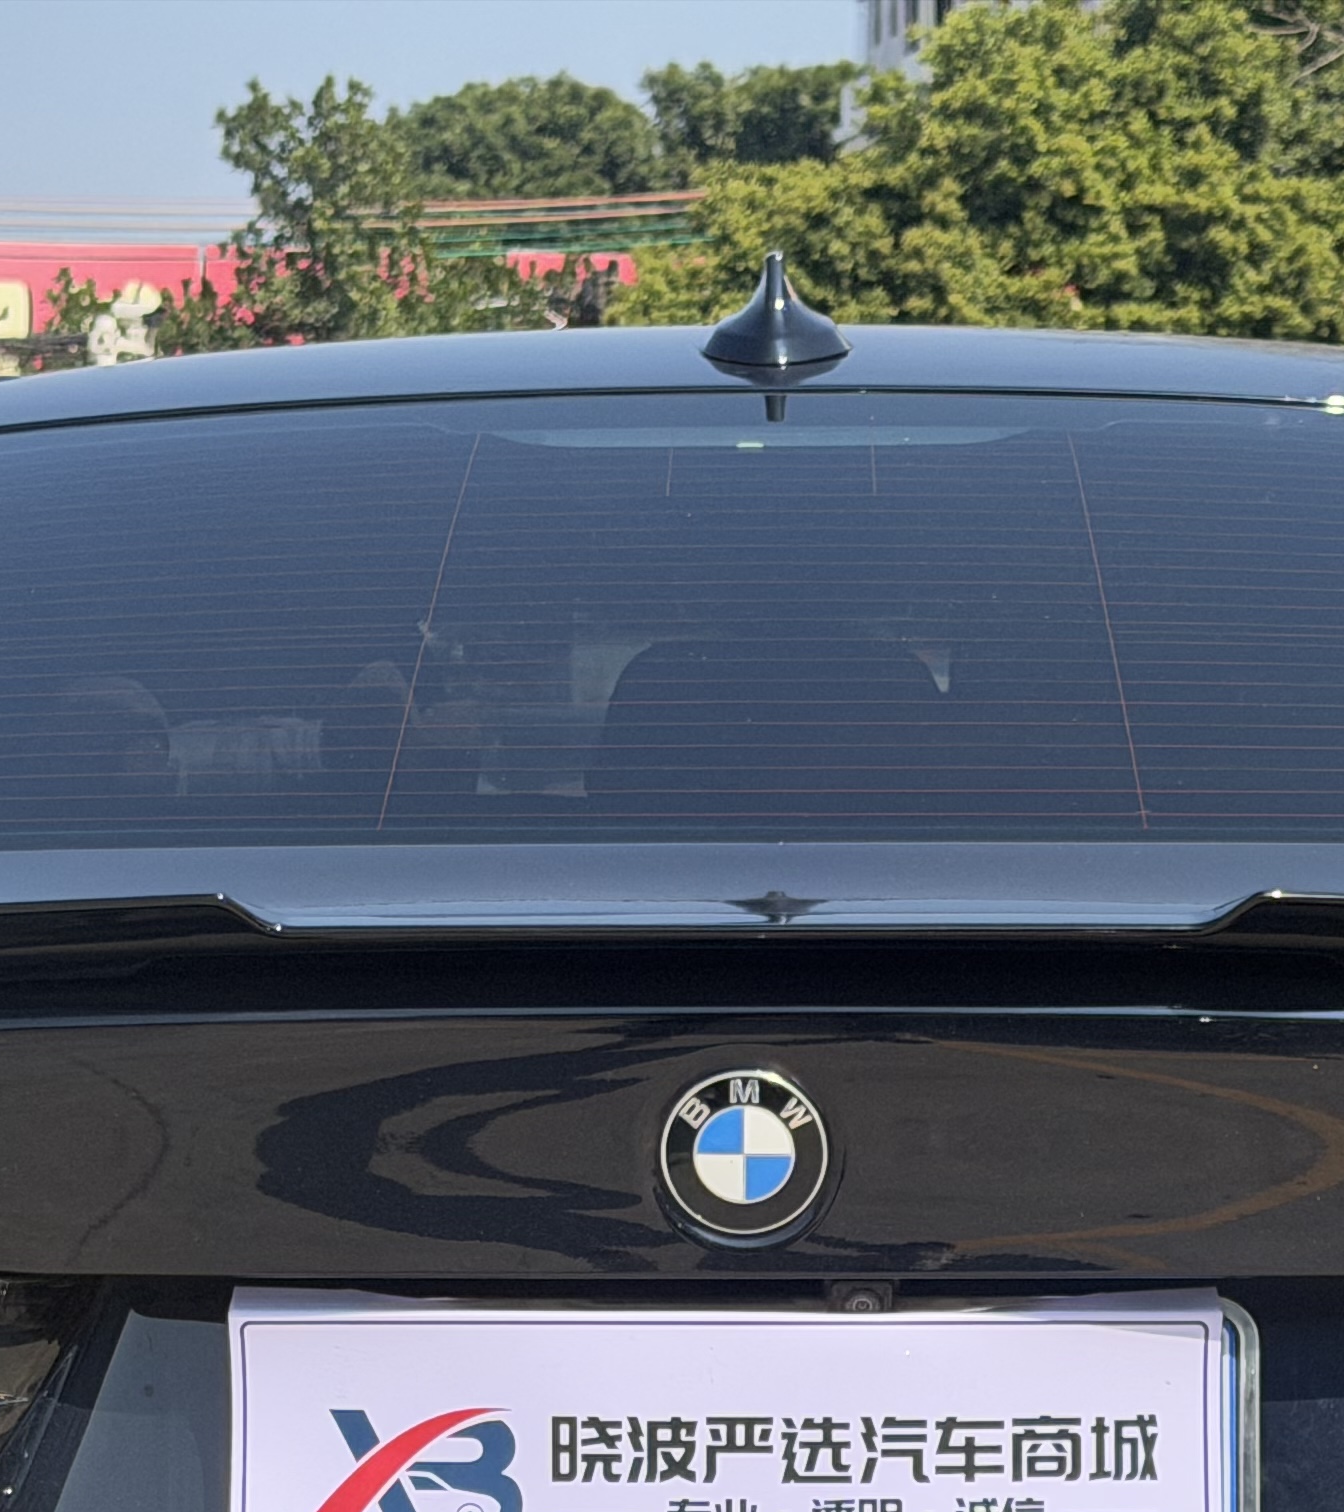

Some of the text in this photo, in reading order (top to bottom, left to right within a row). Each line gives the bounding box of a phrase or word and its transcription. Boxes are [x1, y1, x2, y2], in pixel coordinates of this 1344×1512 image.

[678, 1078, 813, 1130] BMW
[550, 1414, 1159, 1484] 晓波严选汽车商城
